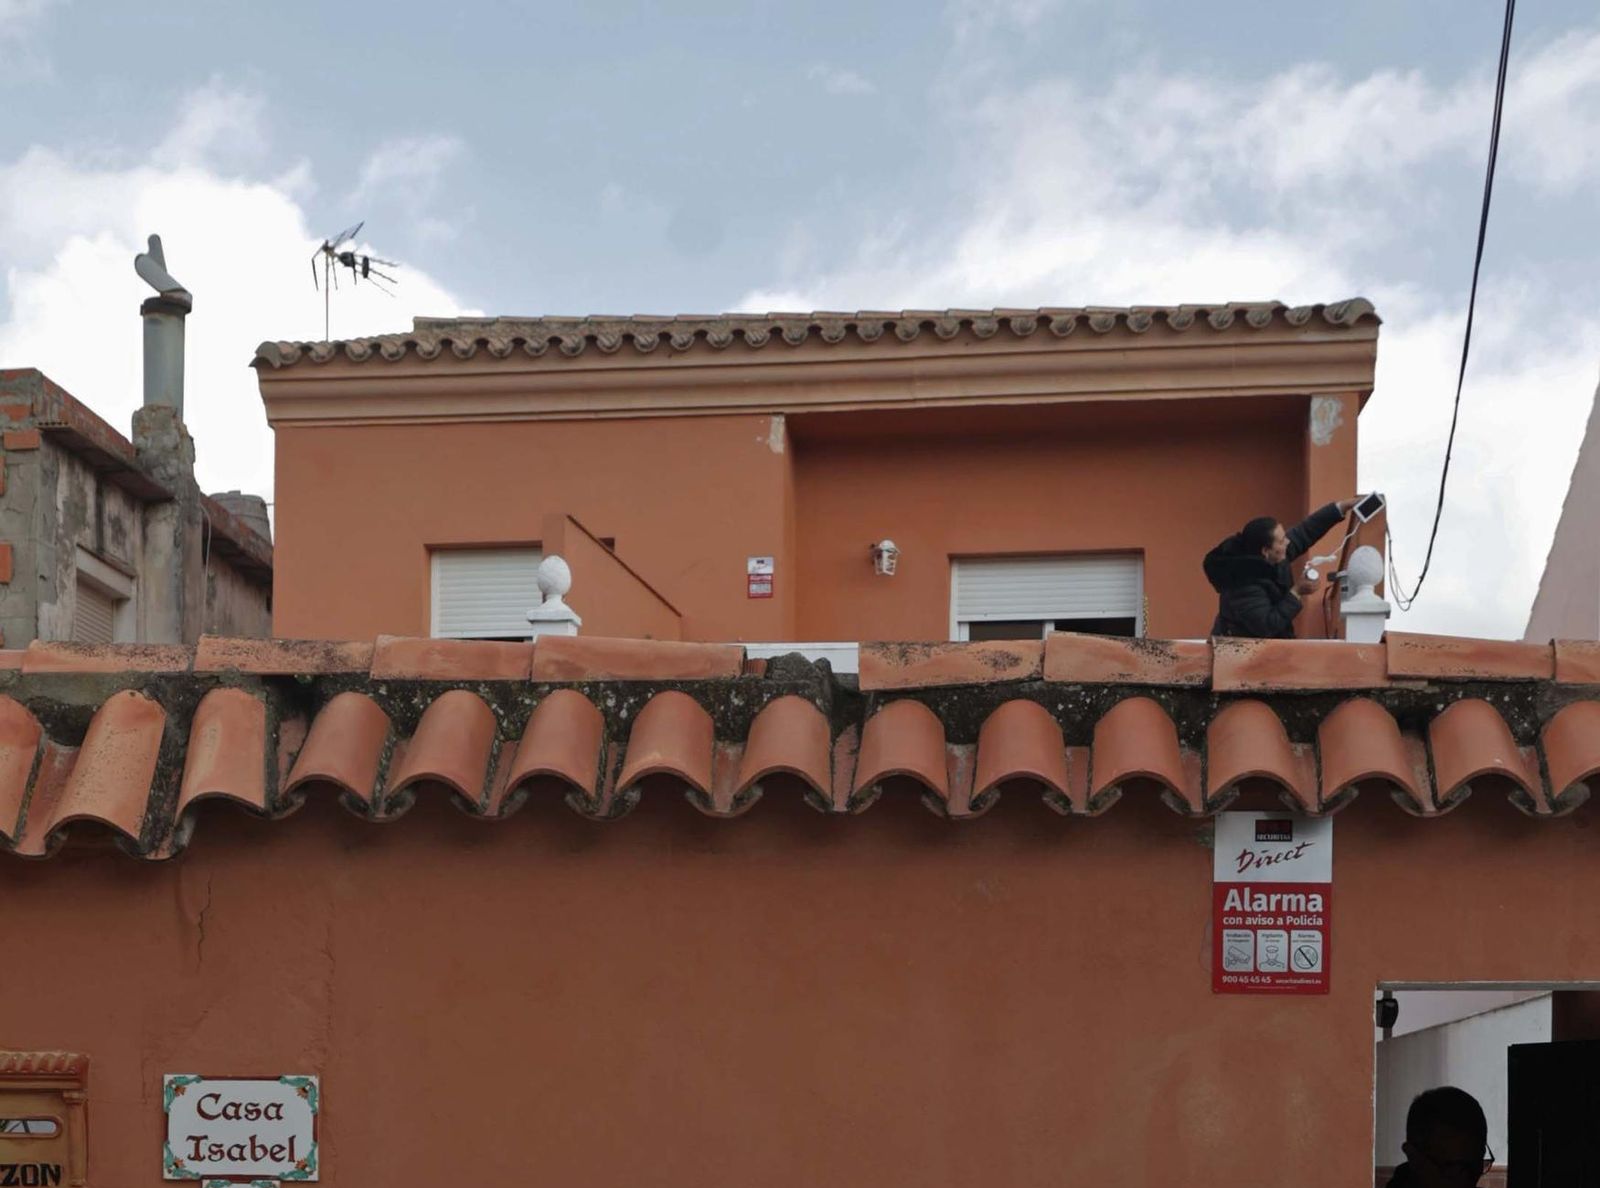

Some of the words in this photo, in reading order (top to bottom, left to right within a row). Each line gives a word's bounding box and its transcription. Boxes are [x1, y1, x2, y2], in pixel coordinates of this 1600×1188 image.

[1236, 841, 1315, 873] Direct
[1223, 887, 1323, 912] Alarma
[1223, 916, 1243, 925] con
[1245, 914, 1274, 925] aviso
[1276, 917, 1283, 925] a
[1222, 975, 1238, 984] 900
[196, 1093, 284, 1121] Casa
[186, 1134, 296, 1163] Isabel
